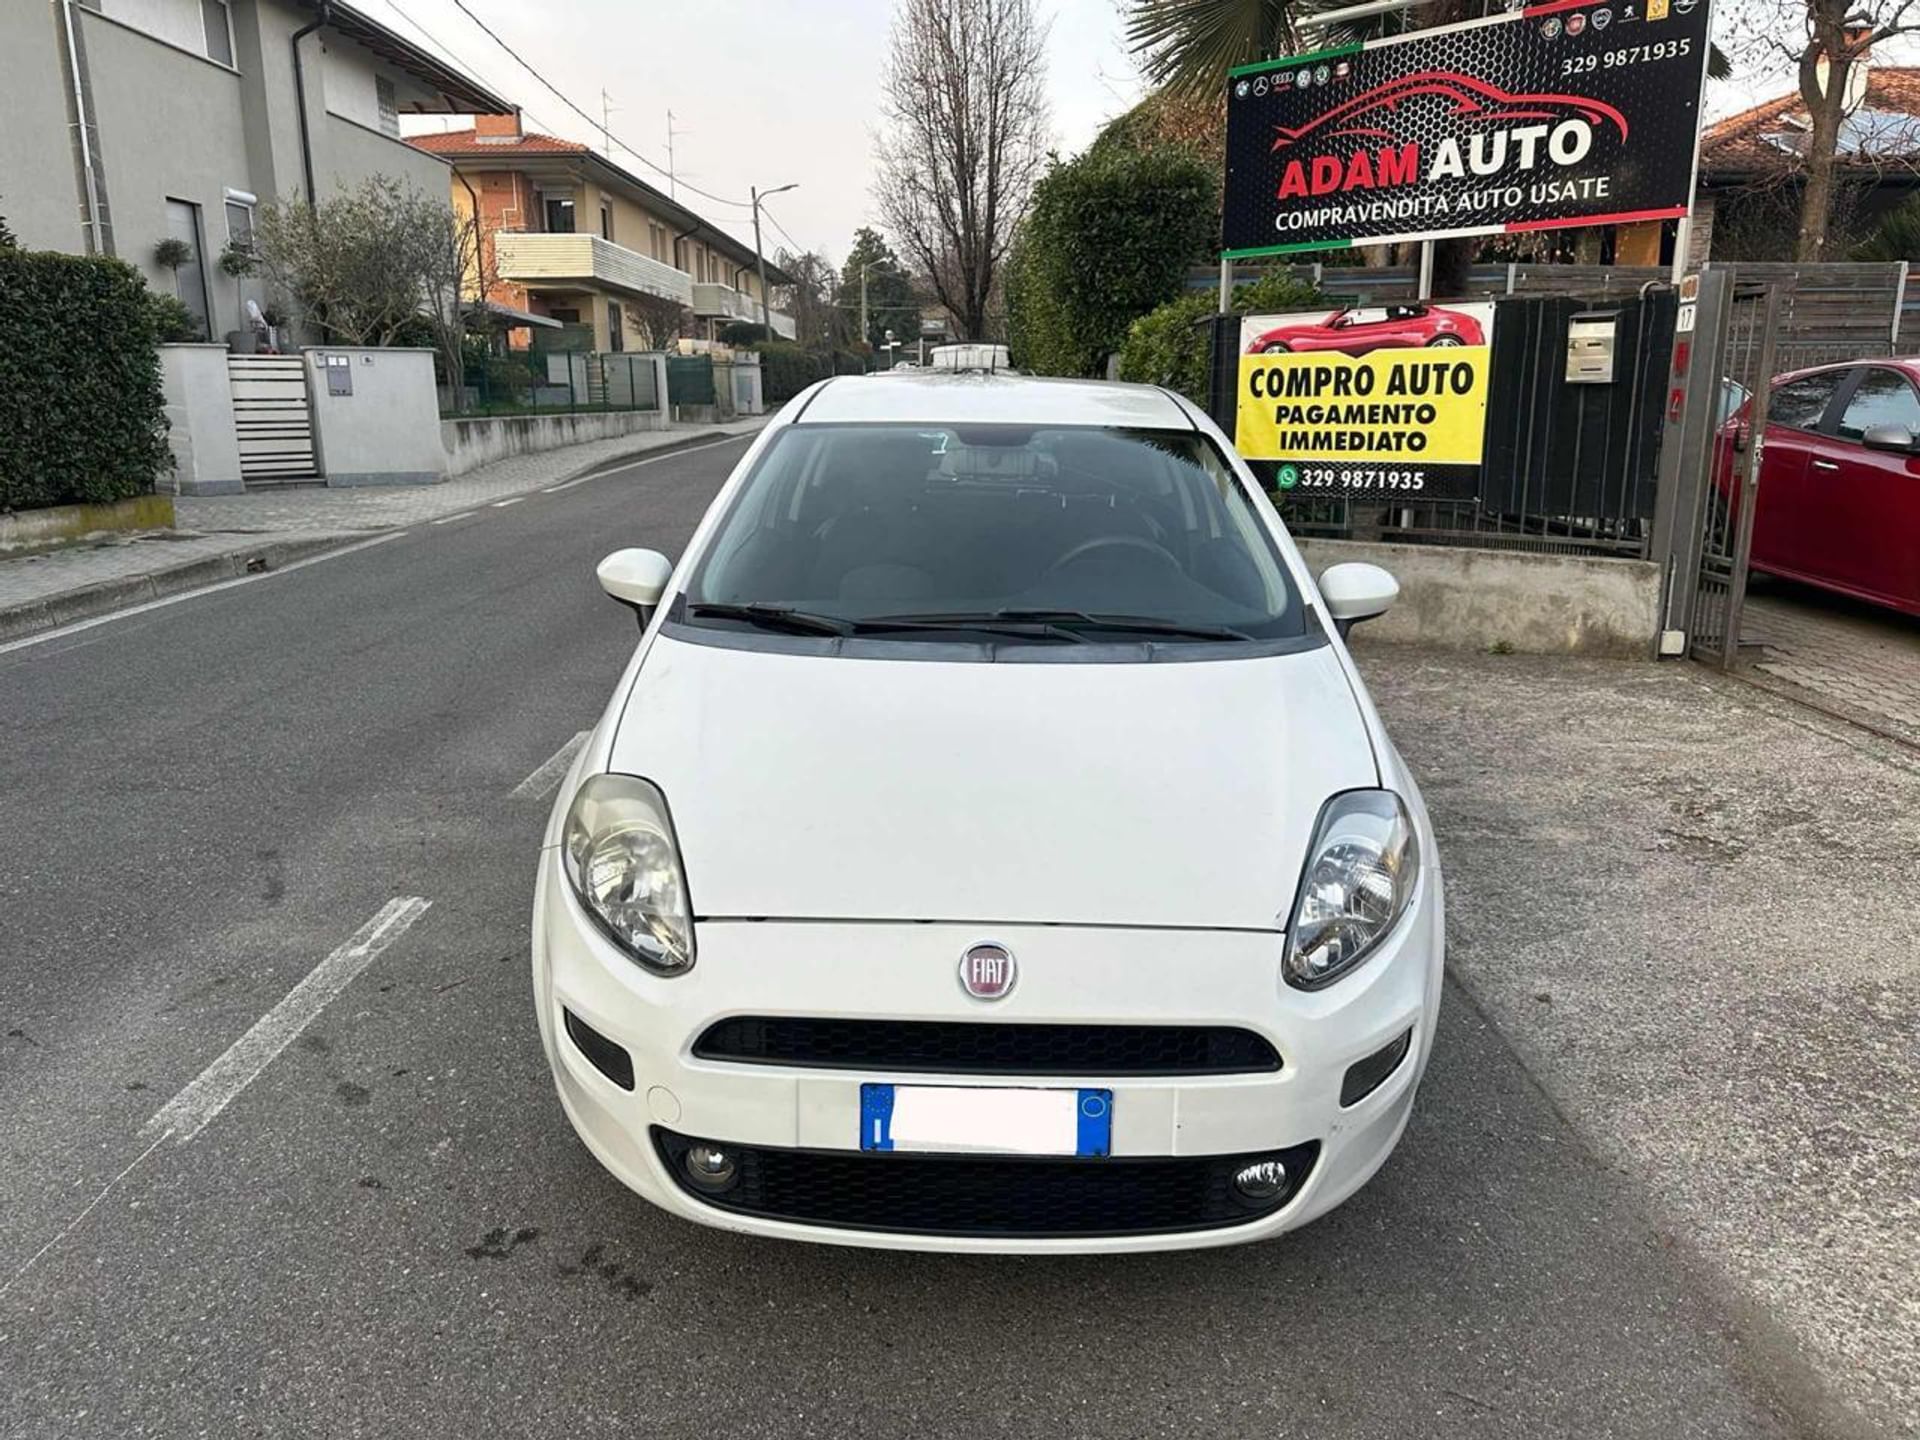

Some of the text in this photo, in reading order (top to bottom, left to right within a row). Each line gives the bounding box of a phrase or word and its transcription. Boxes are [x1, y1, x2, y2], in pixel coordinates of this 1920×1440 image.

[1562, 38, 1691, 76] 329 9871935
[1278, 118, 1593, 199] ADAM AUTO
[1275, 177, 1610, 231] COMPRAVENDITA AUTO USATE
[1680, 308, 1693, 329] 17
[1250, 362, 1475, 398] COMPRO AUTO
[1275, 403, 1437, 425] PAGAMENTO
[1280, 431, 1427, 452] IMMEDIATO
[1301, 469, 1425, 490] 329 9871935
[972, 957, 1005, 984] FIAT
